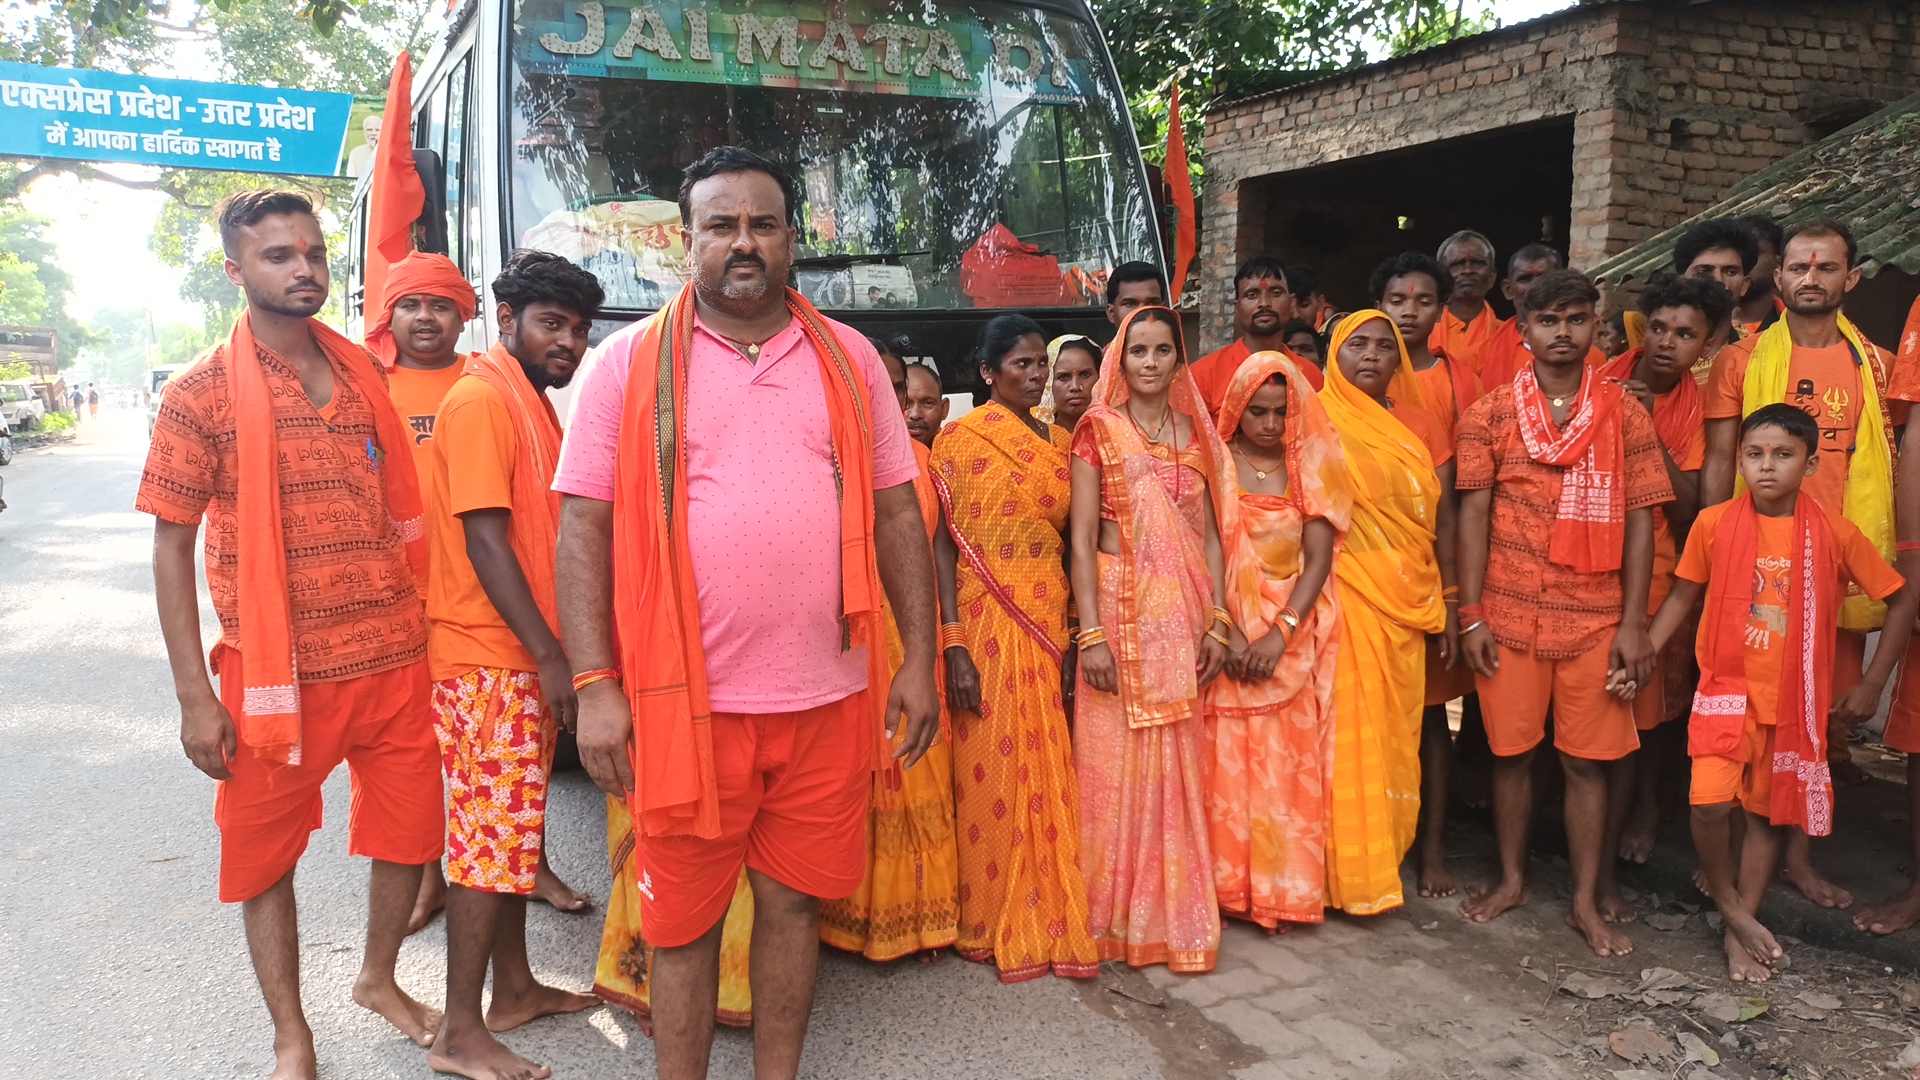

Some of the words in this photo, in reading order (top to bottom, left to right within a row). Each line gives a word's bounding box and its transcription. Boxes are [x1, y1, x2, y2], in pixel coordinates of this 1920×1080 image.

[538, 1, 712, 63] JAI
[734, 13, 971, 82] MATA
[991, 33, 1070, 88] DI
[0, 78, 113, 116] एक्सप्रेस
[117, 84, 182, 122] प्रदेश
[256, 97, 316, 132] प्रदेश
[44, 121, 69, 147] में
[72, 127, 139, 152] आपका
[141, 128, 201, 156] हार्दिक
[203, 137, 265, 161] स्वागत
[266, 137, 282, 162] है
